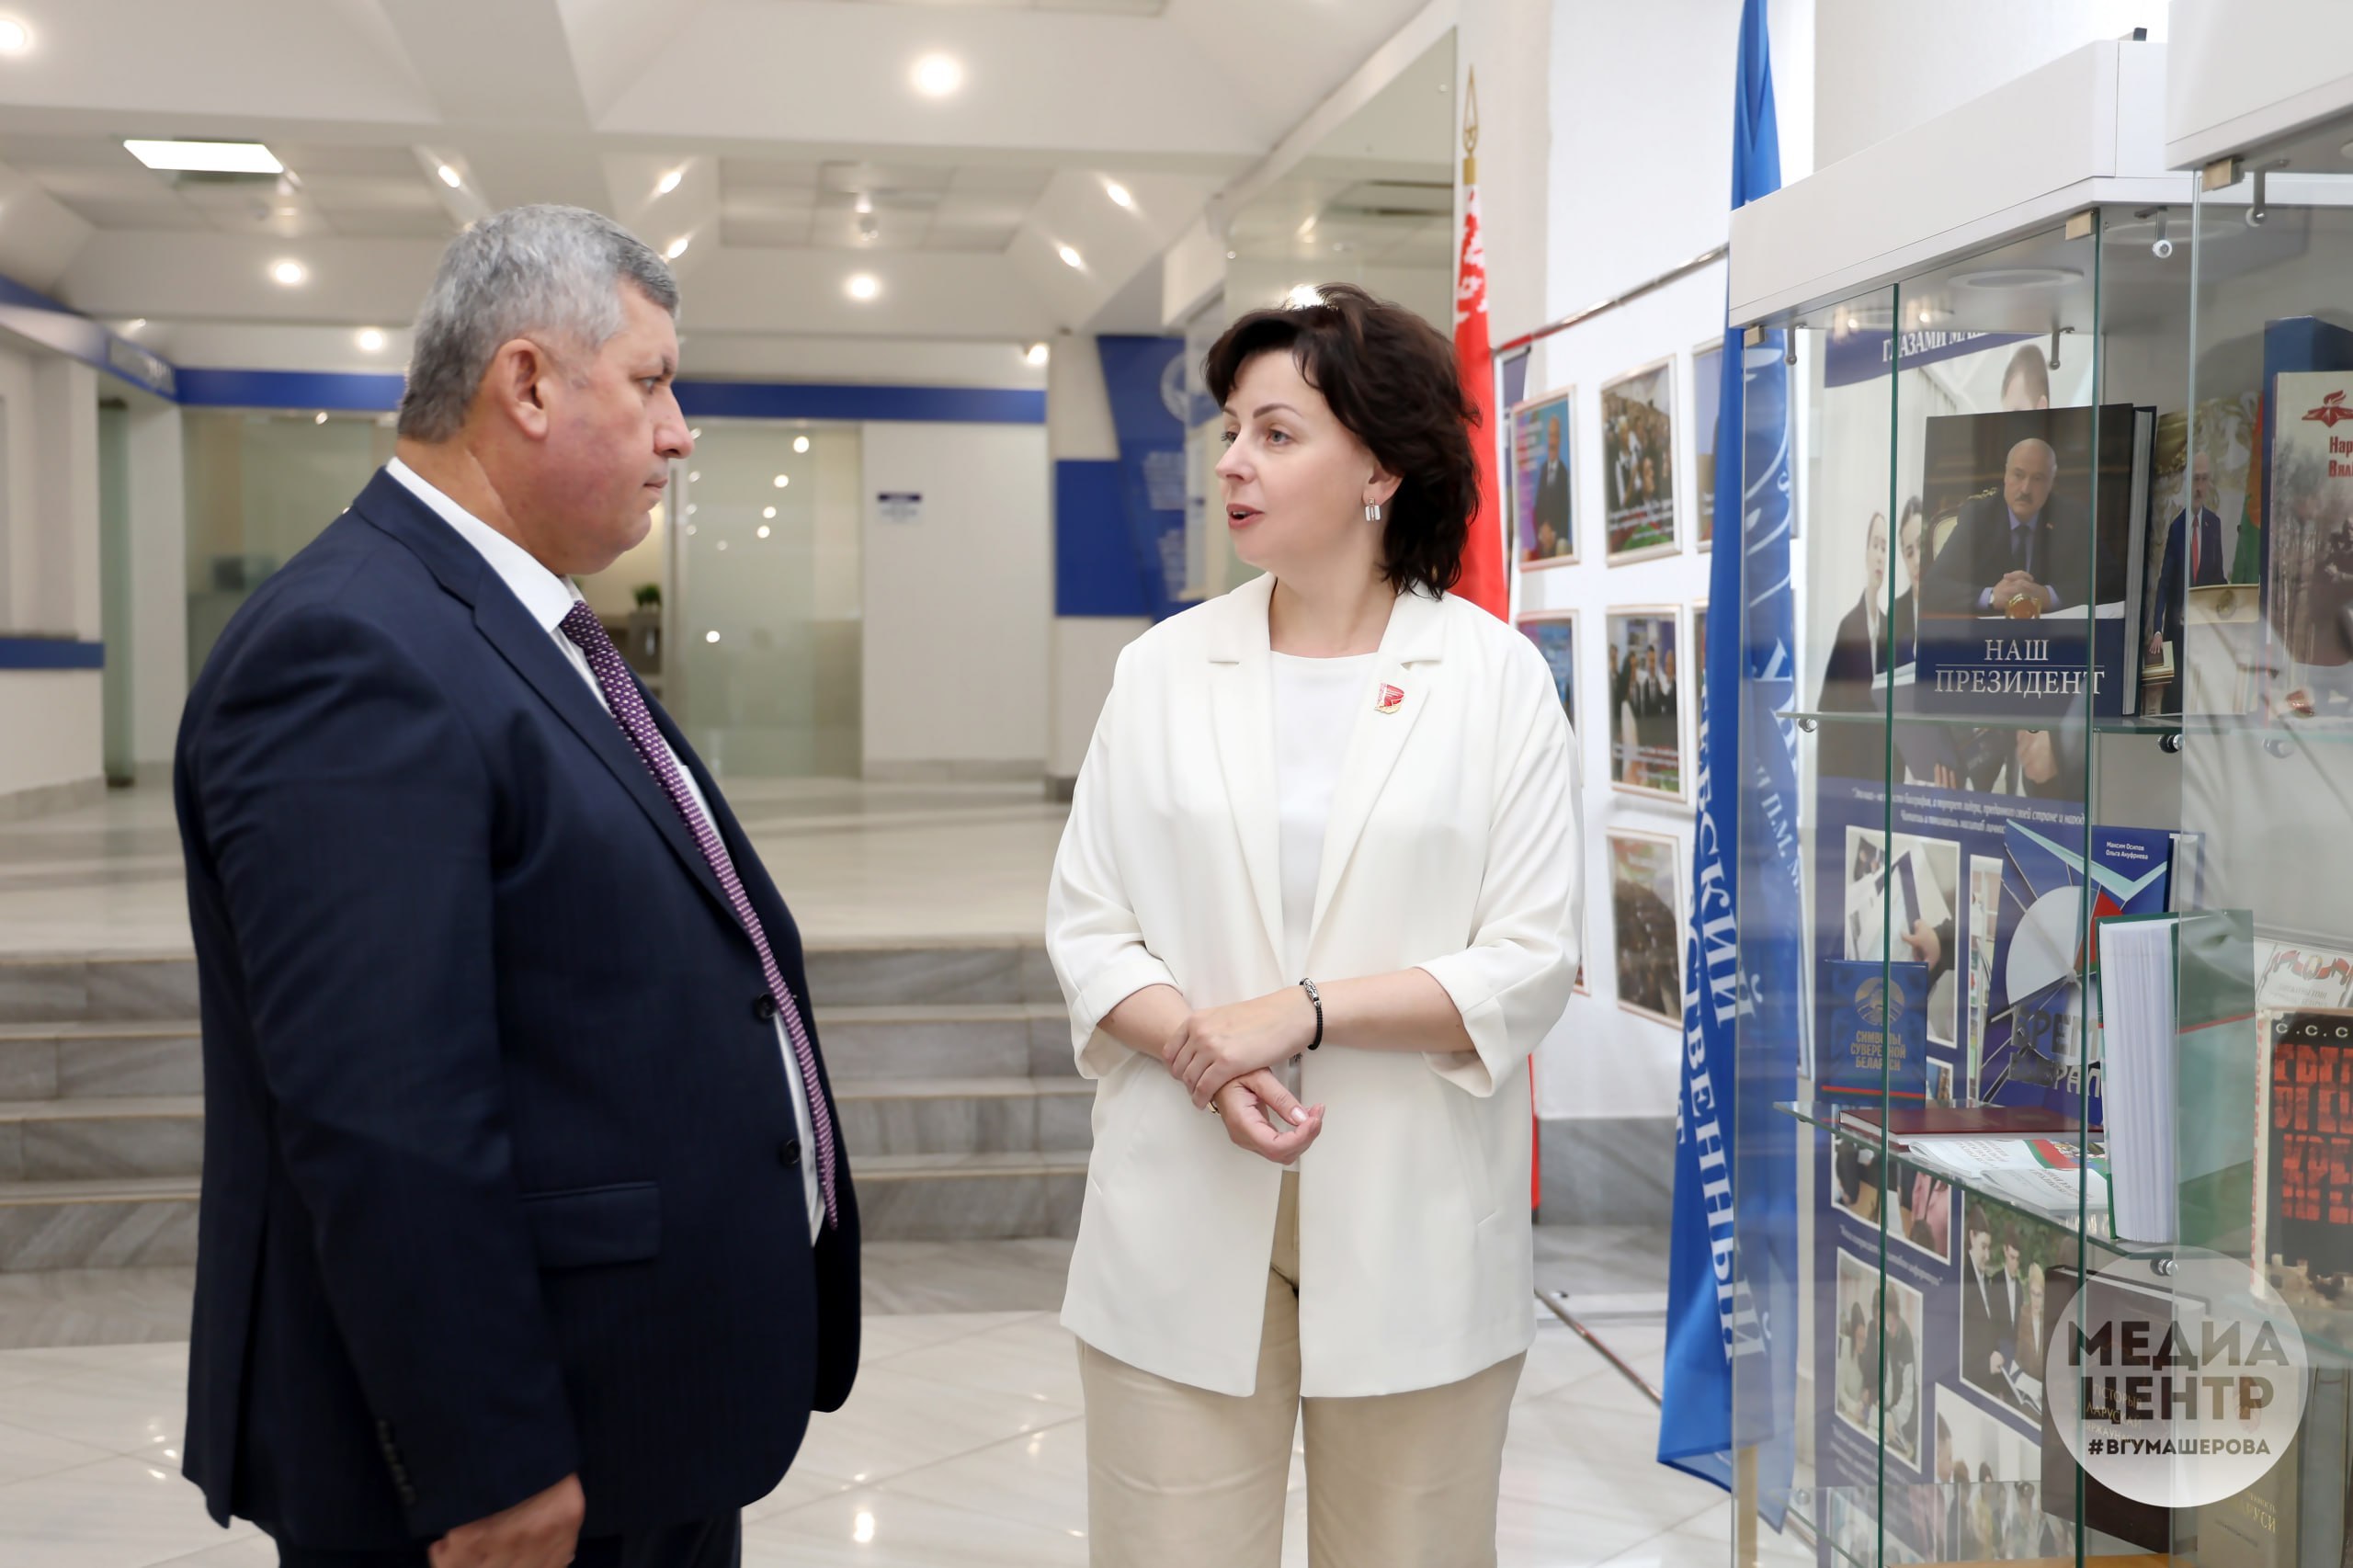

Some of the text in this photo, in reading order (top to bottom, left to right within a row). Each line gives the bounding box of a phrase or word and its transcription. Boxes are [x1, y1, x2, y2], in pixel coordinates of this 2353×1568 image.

[2327, 459, 2353, 479] Вял
[1984, 639, 2049, 661] НАШ
[1935, 670, 2105, 699] ПРЕЗИДЕНТ
[1856, 1030, 1901, 1045] СИМВЛЫ
[1850, 1041, 1906, 1059] СУВЕРЕНОЙ
[1856, 1055, 1901, 1071] БЕЛАРСИ
